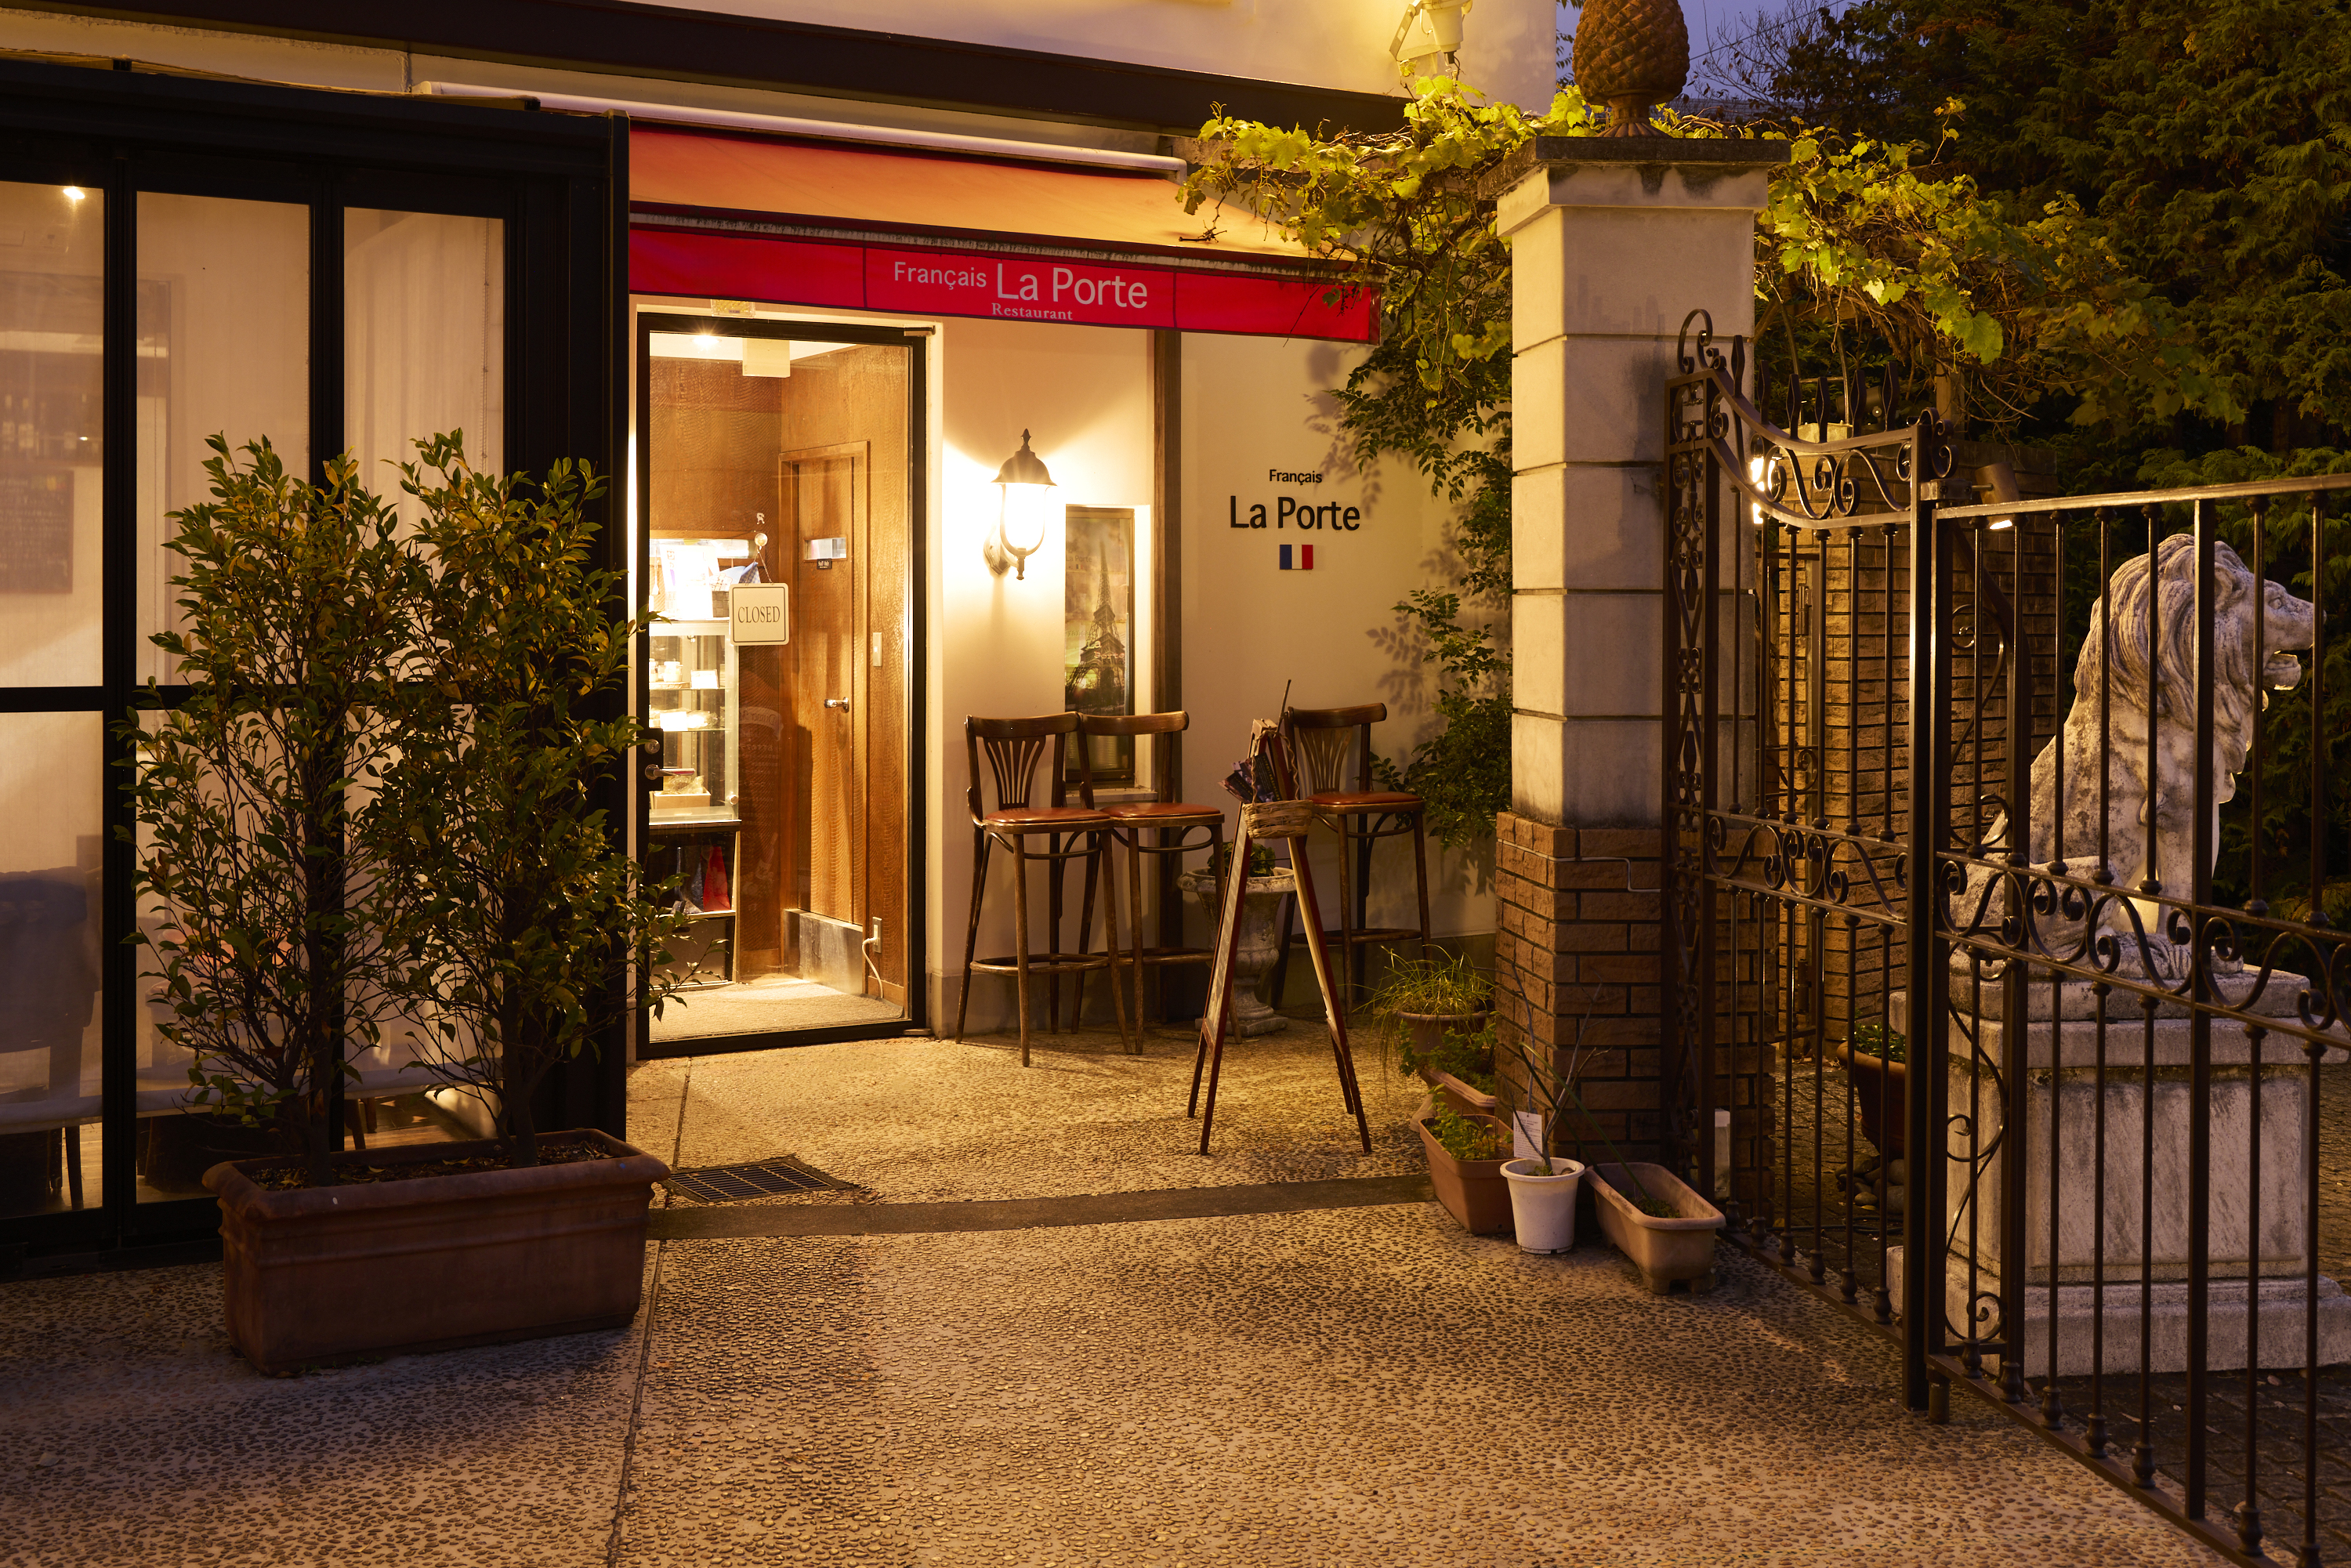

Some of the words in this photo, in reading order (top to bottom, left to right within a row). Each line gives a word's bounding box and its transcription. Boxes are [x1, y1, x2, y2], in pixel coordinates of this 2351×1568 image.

[894, 261, 987, 290] Français
[997, 263, 1039, 302] La
[1052, 267, 1148, 309] Porte
[991, 302, 1073, 320] Restaurant
[1269, 469, 1323, 486] Français
[1230, 495, 1267, 529] La
[1277, 496, 1360, 531] Porte
[737, 606, 781, 624] CLOSED
[1085, 639, 1102, 650] La
